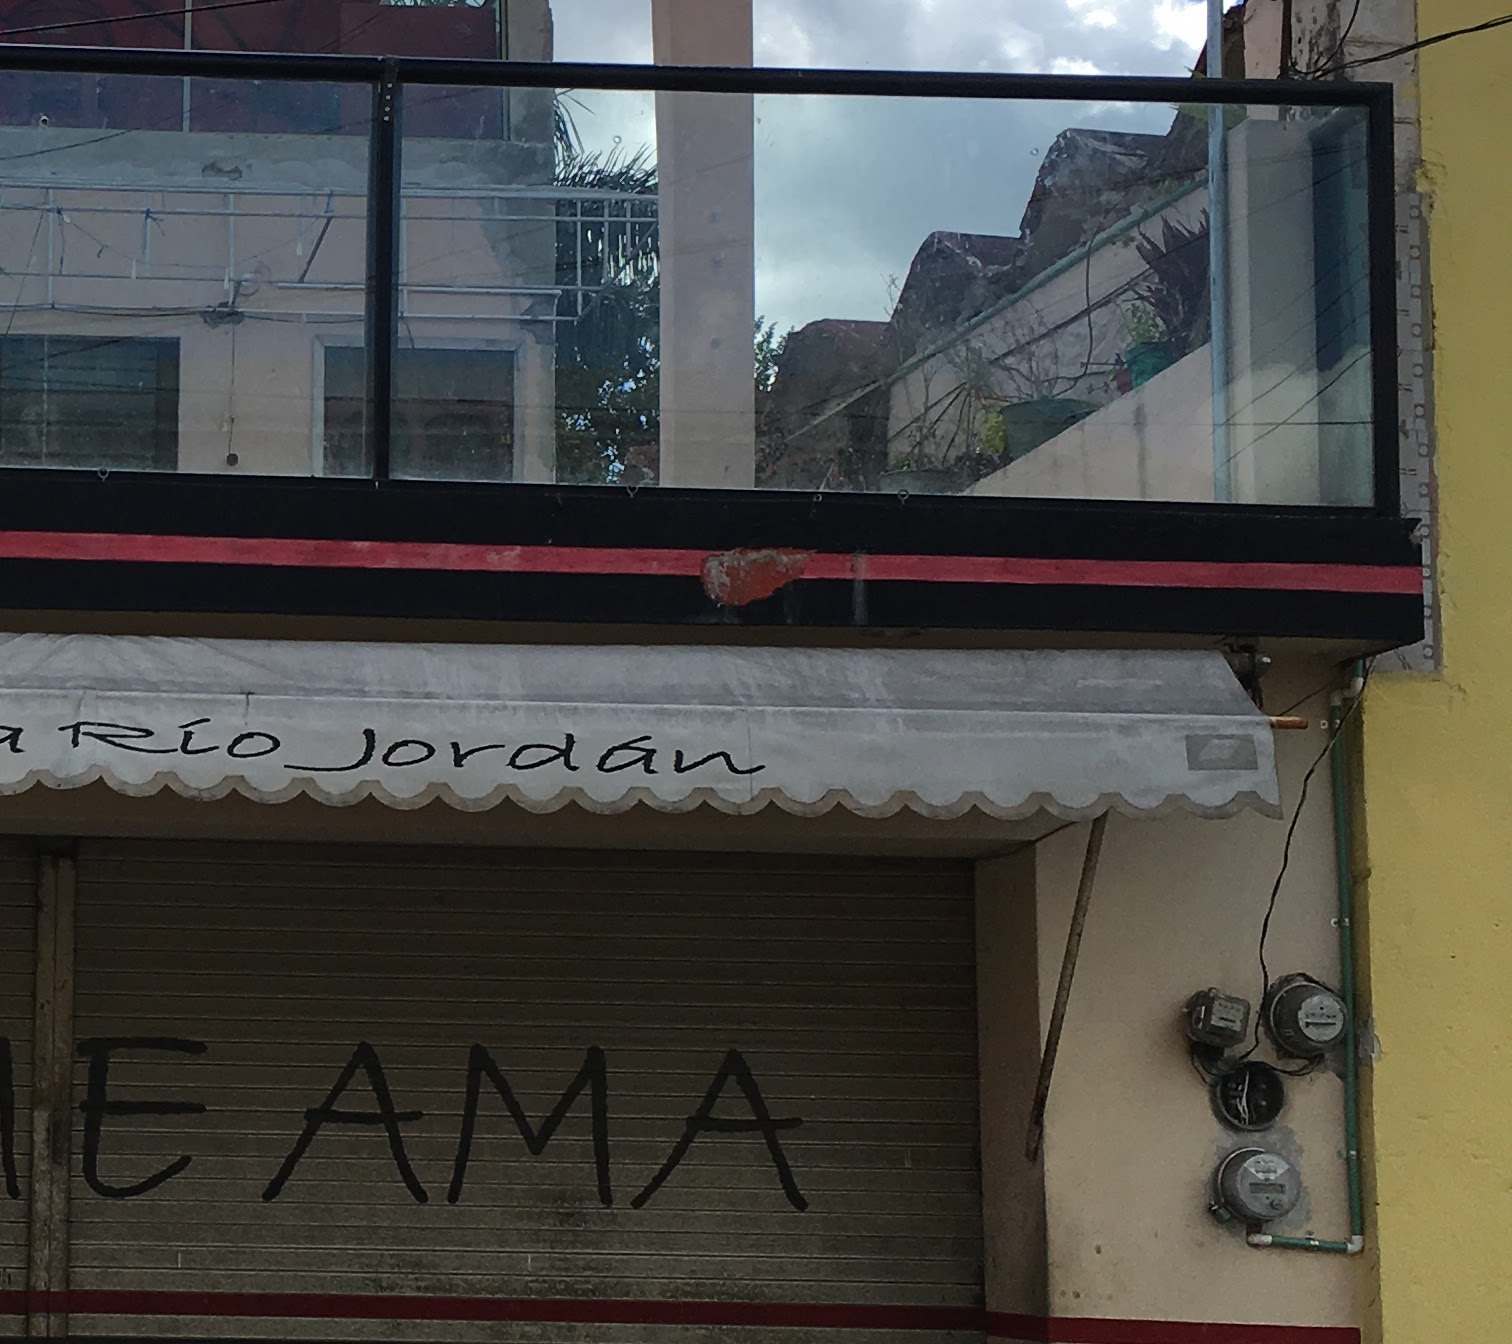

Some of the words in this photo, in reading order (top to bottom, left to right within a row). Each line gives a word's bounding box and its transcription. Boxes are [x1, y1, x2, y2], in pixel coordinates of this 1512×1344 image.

[57, 716, 282, 760] Río
[283, 727, 767, 776] Jordán
[261, 1041, 809, 1213] AMA
